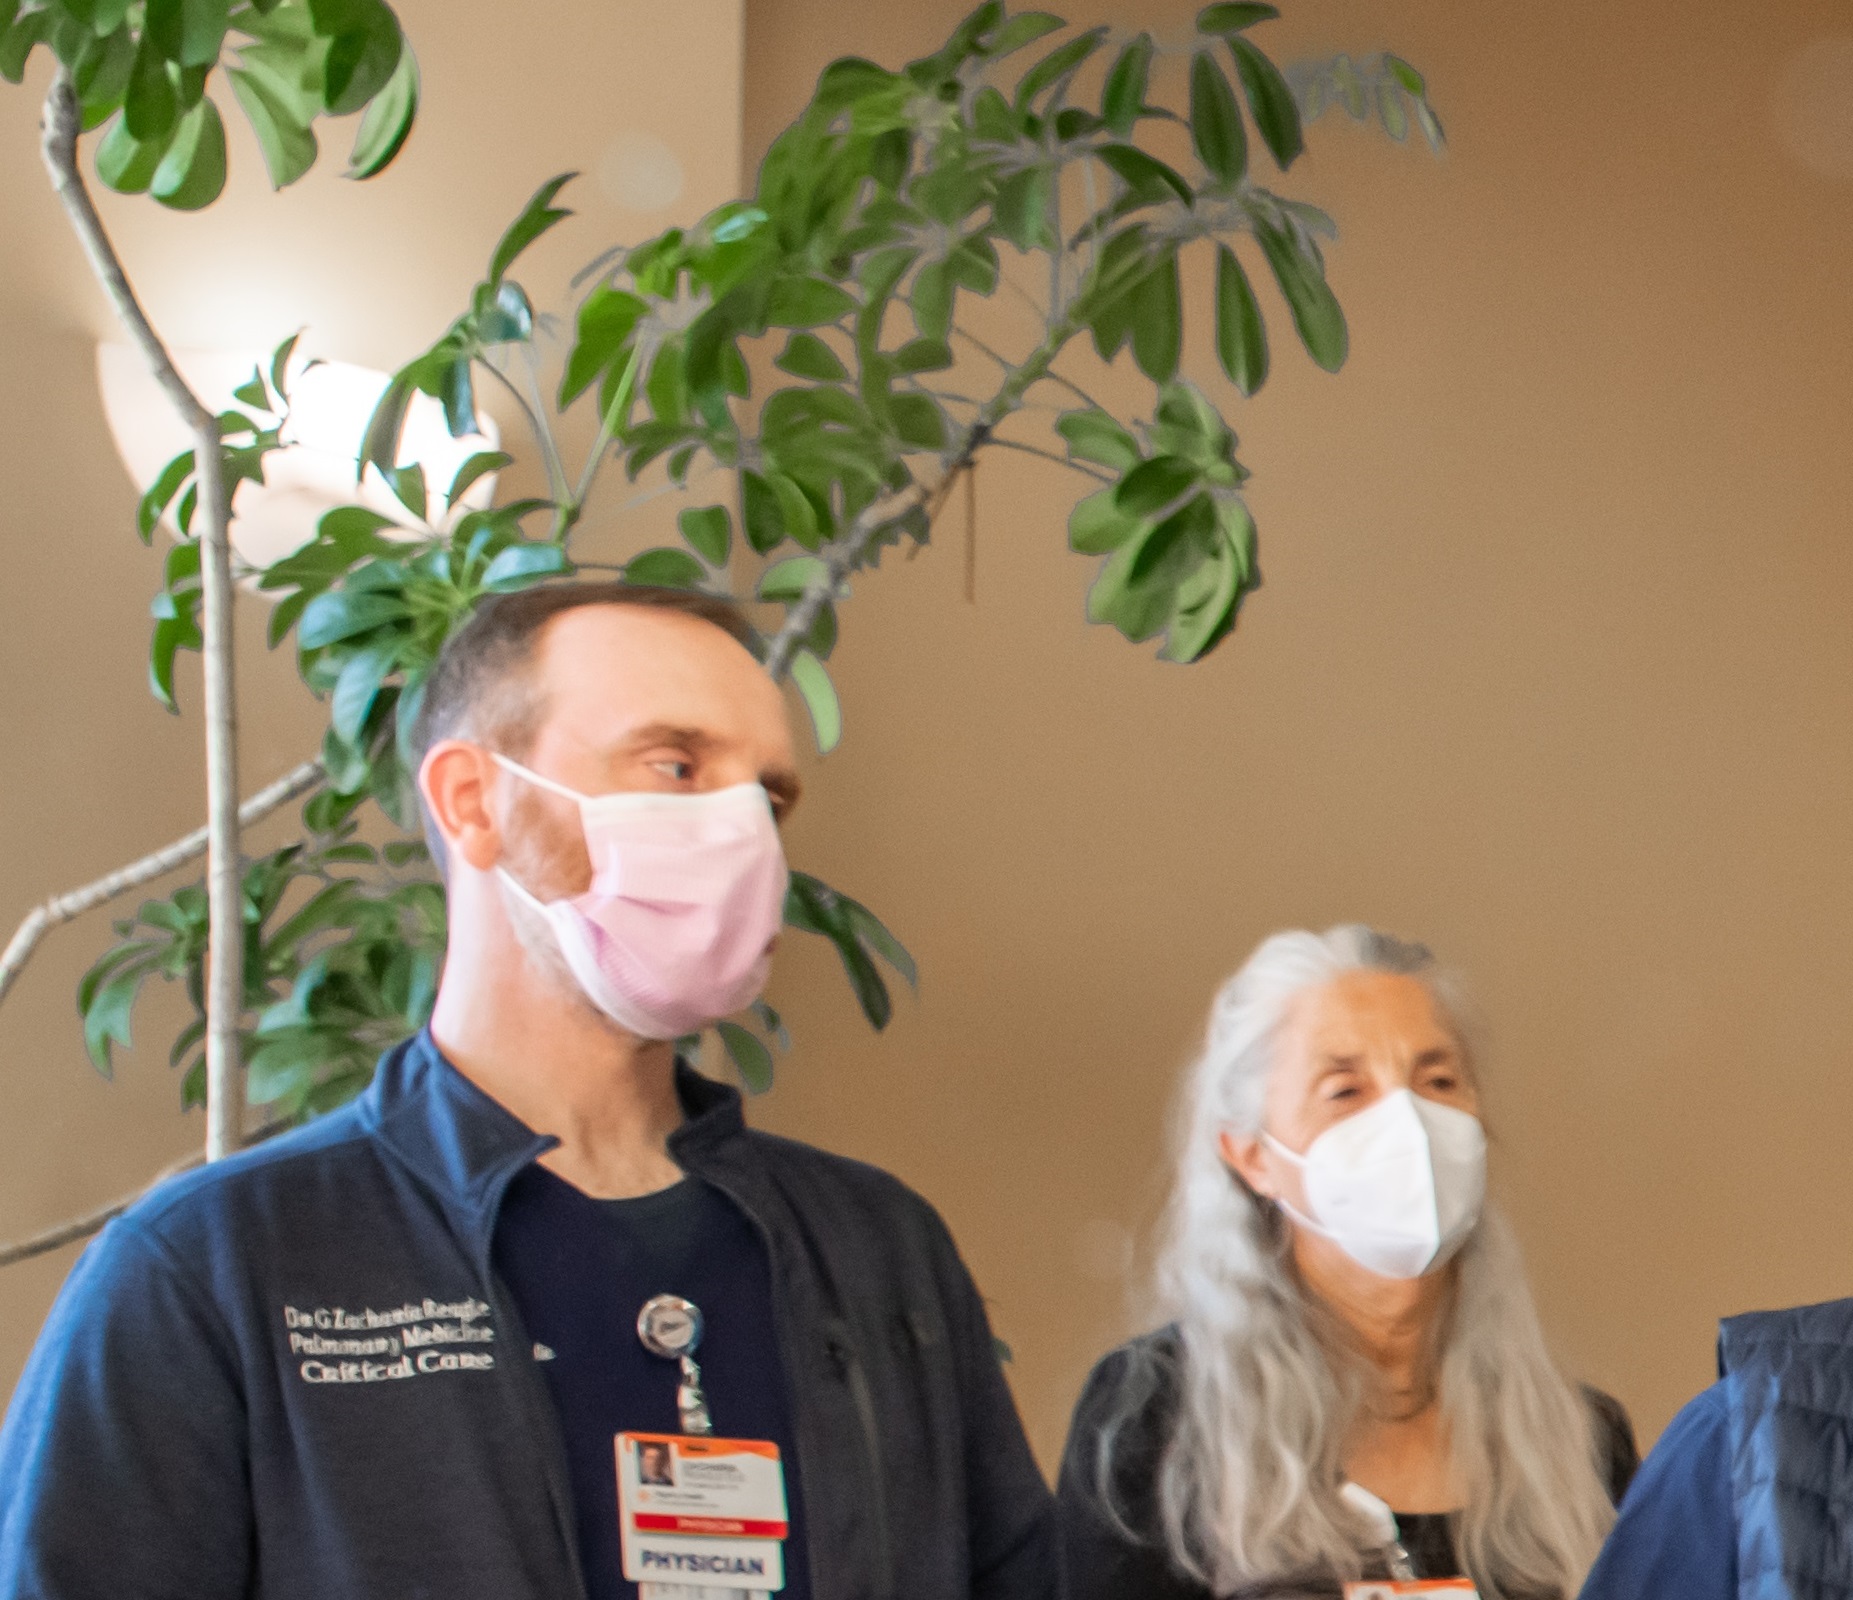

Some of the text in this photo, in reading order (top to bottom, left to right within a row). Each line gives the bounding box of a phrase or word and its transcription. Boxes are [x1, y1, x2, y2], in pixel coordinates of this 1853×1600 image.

[402, 1322, 494, 1348] Medicine
[301, 1349, 494, 1383] Critical Care
[641, 1549, 764, 1576] PHYSICIAN
